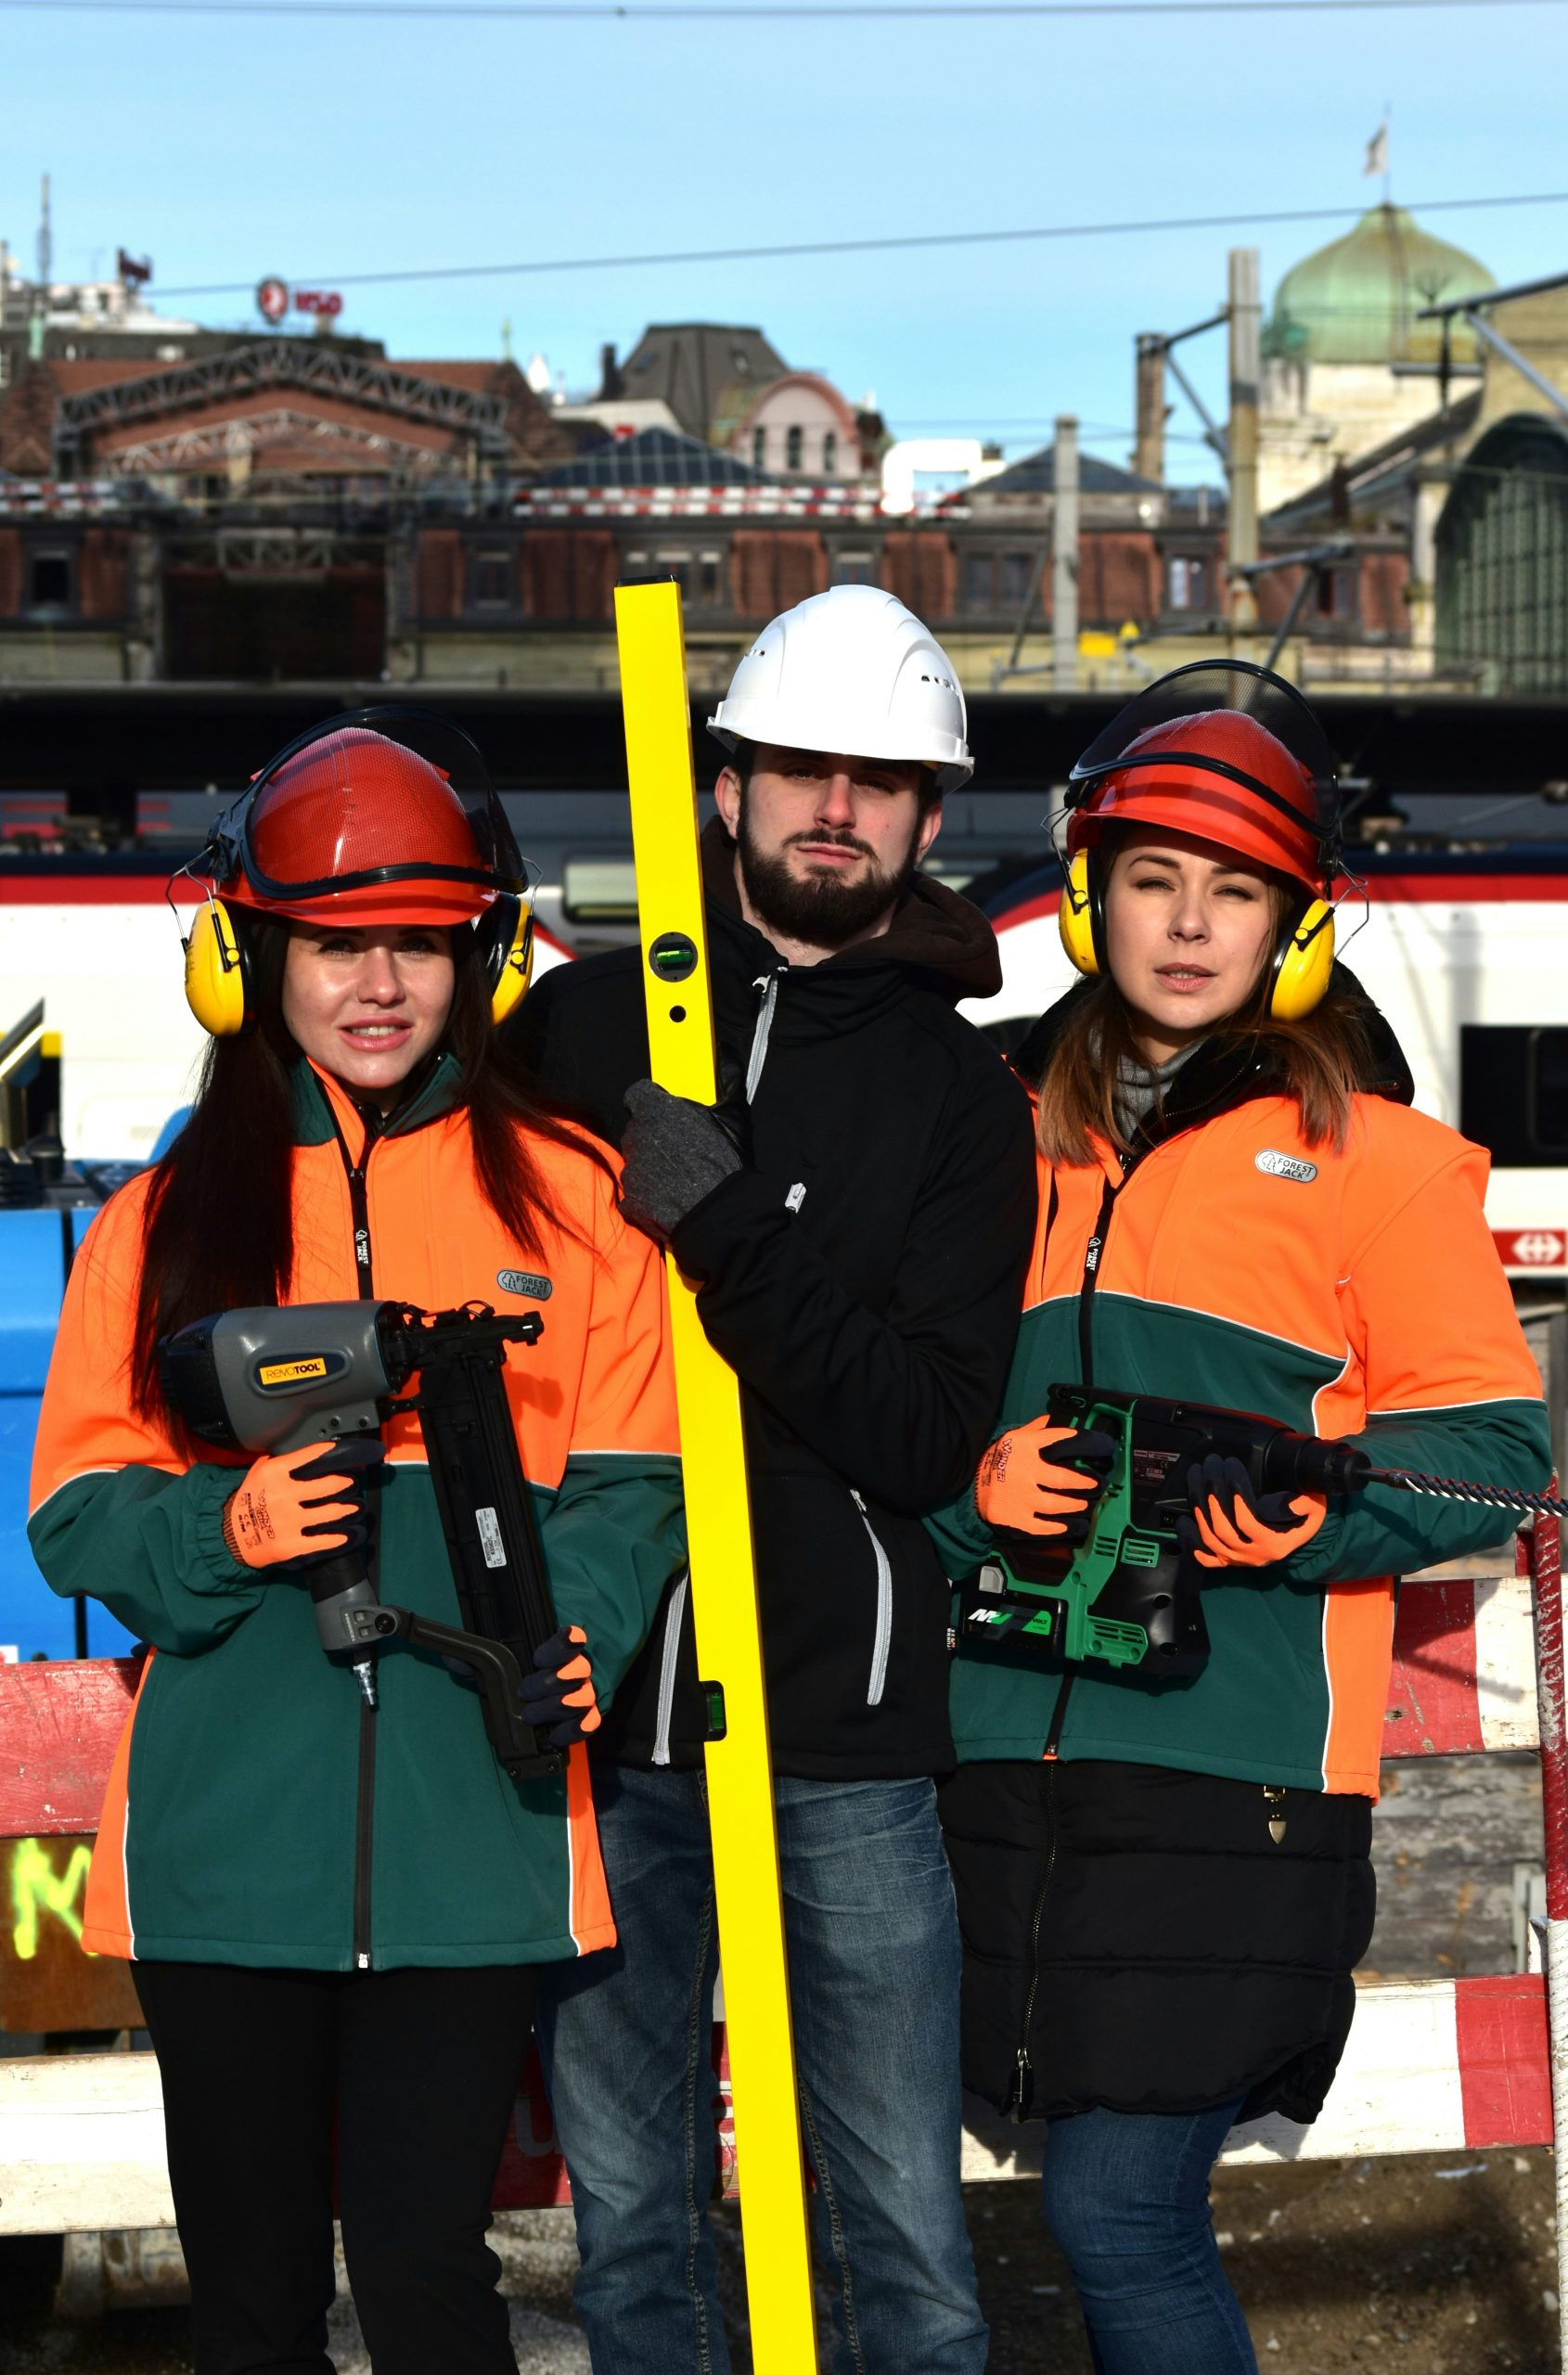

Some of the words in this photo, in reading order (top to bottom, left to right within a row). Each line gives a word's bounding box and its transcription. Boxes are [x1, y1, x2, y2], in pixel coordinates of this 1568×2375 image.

[1278, 1157, 1314, 1175] FOREST
[1279, 1167, 1304, 1179] JACK
[1089, 1248, 1099, 1271] FOREST
[516, 1275, 548, 1290] FOREST
[521, 1284, 542, 1297] JACK
[996, 1438, 1012, 1483] WONDER
